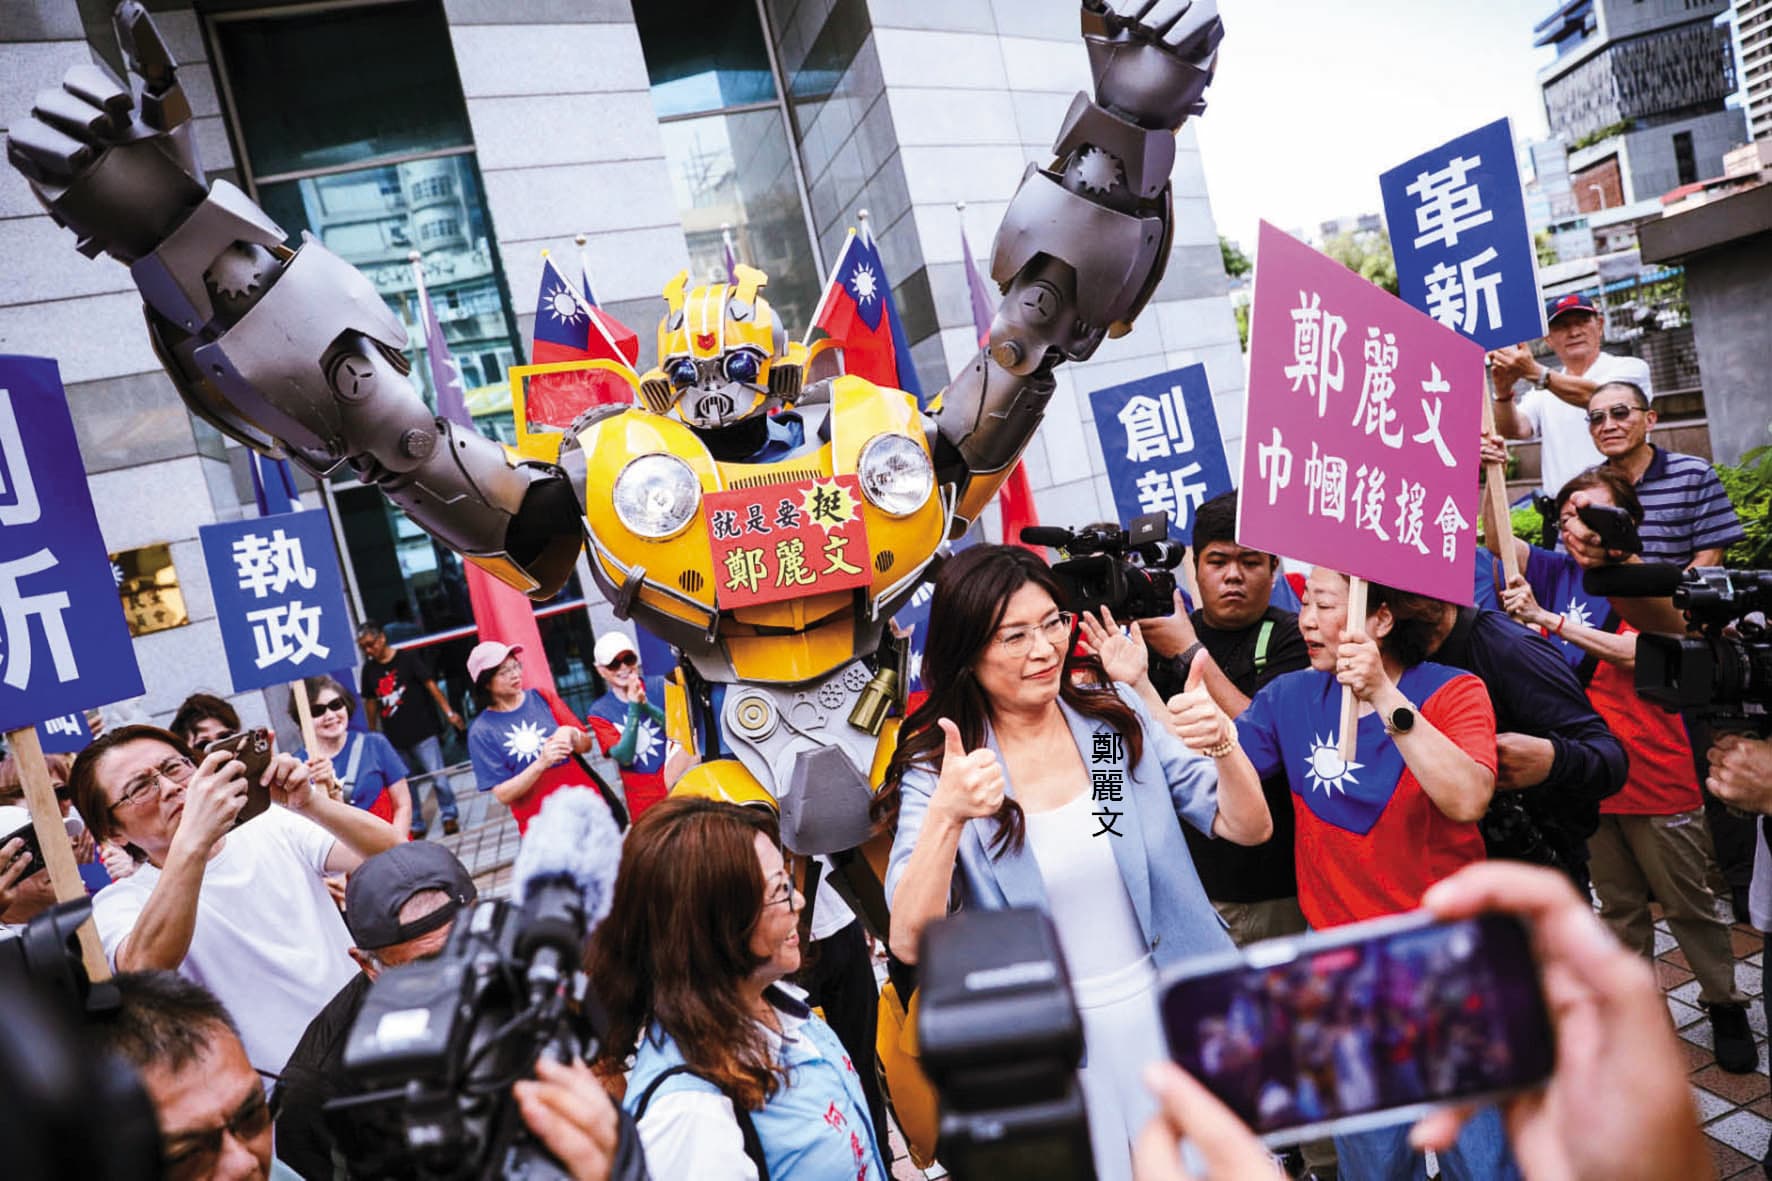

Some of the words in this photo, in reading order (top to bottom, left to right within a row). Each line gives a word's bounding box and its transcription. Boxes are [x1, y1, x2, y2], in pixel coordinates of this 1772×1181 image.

[1406, 155, 1503, 335] 革新
[1284, 290, 1457, 467] 鄭麗文
[1117, 385, 1208, 530] 創新
[1258, 427, 1470, 563] 巾幗後援會
[0, 388, 80, 691] 新
[232, 529, 331, 669] 執政
[724, 535, 863, 593] 鄭麗文
